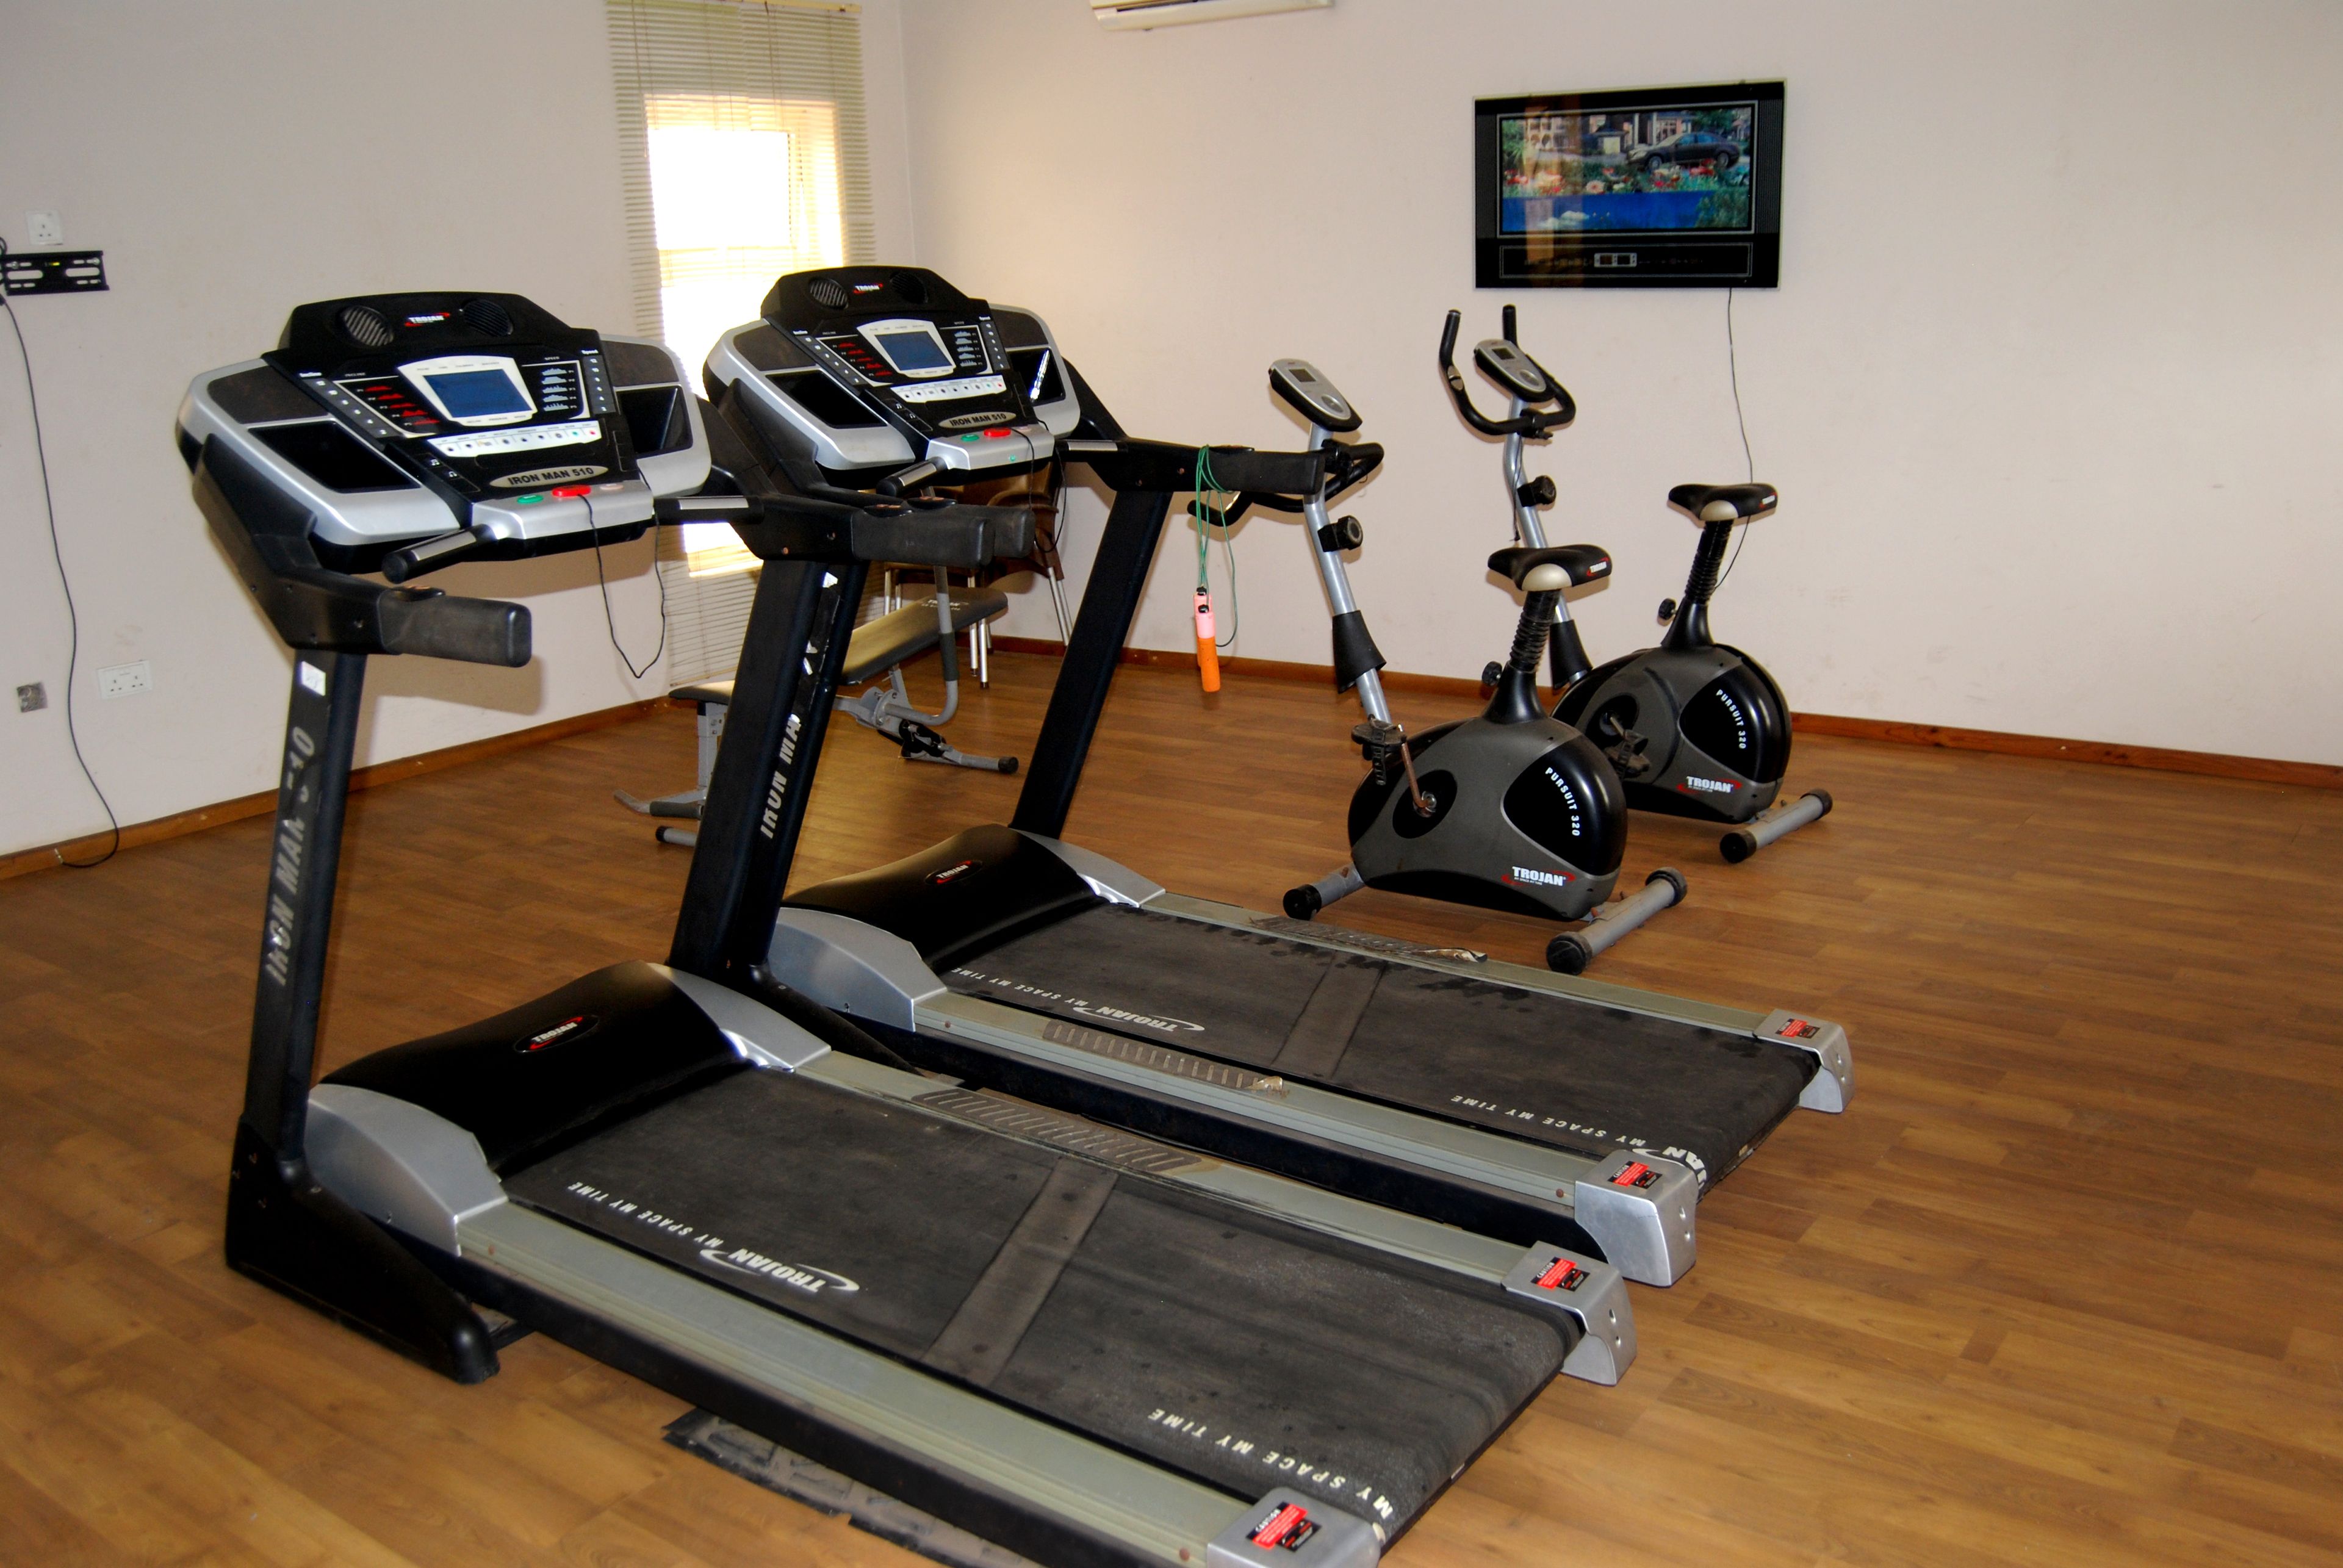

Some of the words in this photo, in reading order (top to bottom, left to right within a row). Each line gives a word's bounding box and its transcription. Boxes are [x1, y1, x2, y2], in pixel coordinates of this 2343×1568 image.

[949, 417, 971, 426] IRON
[975, 415, 991, 424] MAN
[992, 412, 1007, 422] 510
[507, 473, 539, 486] IRON
[544, 470, 570, 481] MAN
[574, 467, 594, 477] 510
[1716, 689, 1744, 726] PURSUIT
[1738, 730, 1746, 749] 320
[1686, 776, 1732, 793] TROJAN
[1545, 767, 1577, 810] PURSUIT
[1571, 815, 1580, 836] 320
[936, 865, 968, 878] TROJAN
[1512, 866, 1564, 886] TROJAN
[951, 967, 986, 980] TIME
[988, 978, 1012, 987] MY
[1014, 984, 1062, 1001] SPACE
[1065, 998, 1088, 1007] MY
[1096, 1005, 1178, 1032] TROJAN
[531, 1022, 578, 1042] TROJAN
[1450, 1095, 1497, 1112] TIME
[1505, 1109, 1535, 1120] MY
[1542, 1117, 1607, 1138] SPACE
[1615, 1135, 1646, 1146] MY
[567, 1181, 609, 1202] TIME
[609, 1198, 638, 1213] MY
[637, 1210, 694, 1236] SPACE
[694, 1233, 724, 1248] MY
[729, 1247, 827, 1293] TROJAN
[1148, 1408, 1207, 1438] TIME
[1215, 1434, 1254, 1455] MY
[1262, 1450, 1346, 1489] SPACE
[1356, 1486, 1394, 1520] MY
[1255, 1508, 1281, 1533] CAUTION
